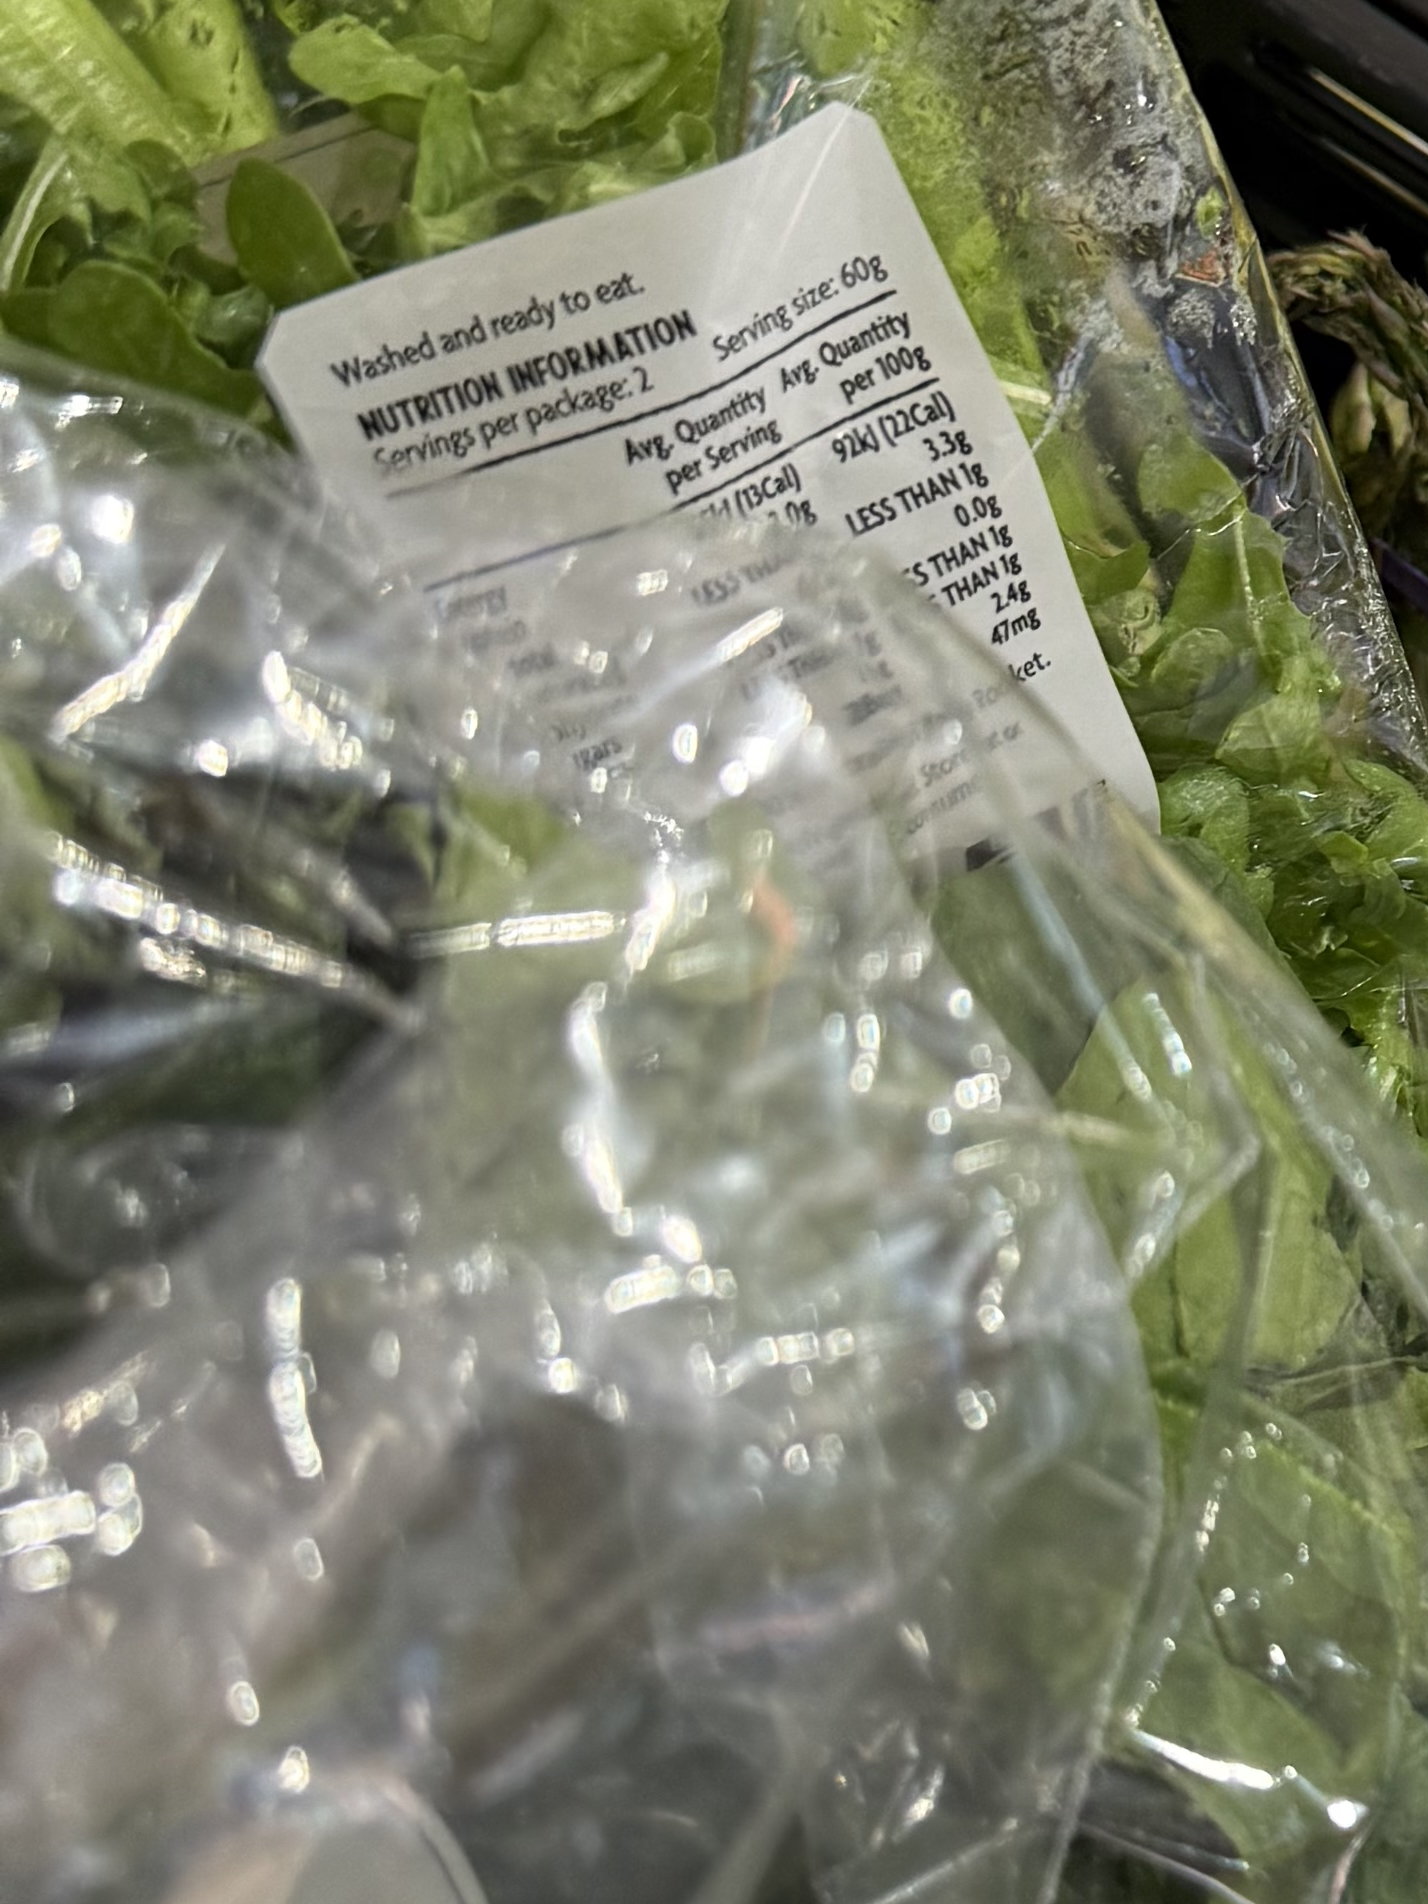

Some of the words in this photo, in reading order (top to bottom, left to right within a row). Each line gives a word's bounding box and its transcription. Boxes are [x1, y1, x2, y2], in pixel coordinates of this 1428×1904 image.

[330, 332, 436, 387] Washed
[439, 315, 488, 354] and
[491, 295, 556, 339] ready
[561, 291, 591, 315] to
[595, 271, 646, 305] eat.
[712, 304, 794, 362] Serving
[791, 276, 840, 317] size:
[840, 253, 889, 289] 60g
[357, 369, 505, 442] NUTRITION
[507, 308, 698, 395] INFORMATION
[780, 359, 820, 393] Avg.
[818, 311, 912, 367] Quantity
[838, 369, 875, 405] per
[879, 344, 932, 381] 100g
[374, 424, 476, 473] Servings
[480, 417, 518, 448] per
[525, 377, 631, 436] package:
[632, 367, 655, 394] 2
[624, 428, 674, 466] Avg.
[675, 386, 767, 445] Quantity
[878, 390, 957, 448] (22Cal)
[922, 428, 974, 462] 3.3g
[664, 458, 704, 496] per
[706, 419, 783, 471] Serving
[735, 462, 802, 520] (13Cal)
[845, 495, 898, 538] LESS
[893, 467, 960, 514] THAN
[959, 460, 989, 490] 1g
[953, 493, 1004, 528] 0.0g
[929, 536, 990, 581] THAN
[988, 523, 1014, 551] 1g
[940, 566, 999, 608] THAN
[998, 551, 1023, 577] 1g
[989, 578, 1033, 614] 2.4g
[989, 607, 1042, 646] 47mg
